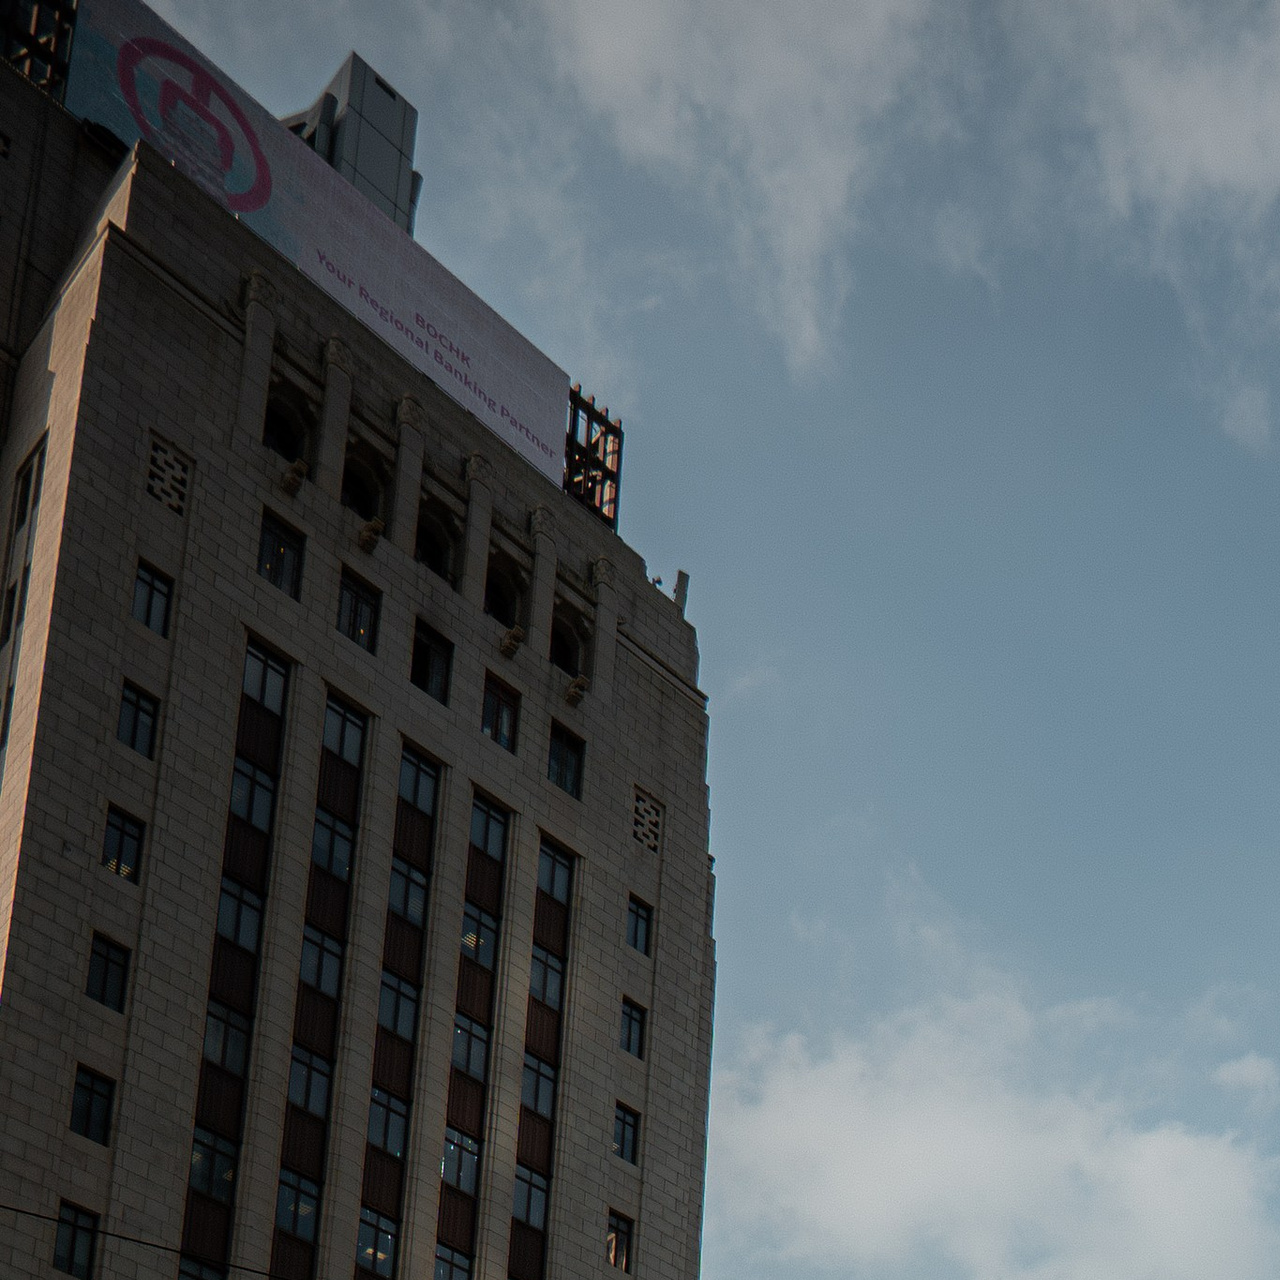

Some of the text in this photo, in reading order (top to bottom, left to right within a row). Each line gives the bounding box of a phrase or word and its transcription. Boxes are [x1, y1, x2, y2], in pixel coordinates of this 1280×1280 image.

[316, 249, 557, 459] Your Regional Banking Partner
[414, 312, 471, 368] BOCHK
